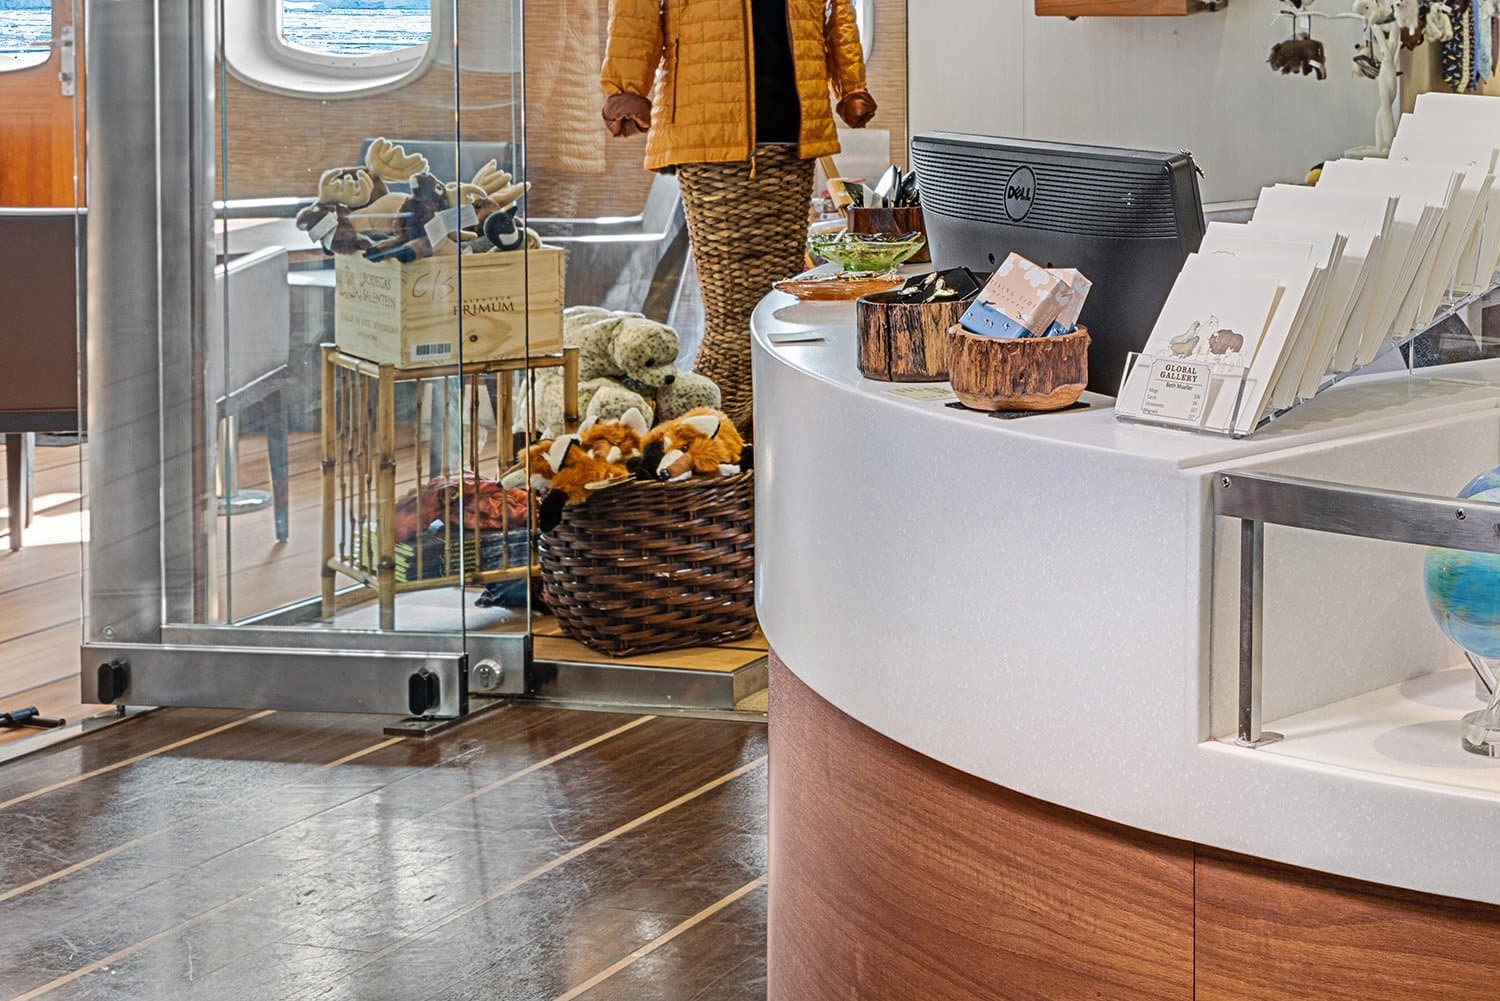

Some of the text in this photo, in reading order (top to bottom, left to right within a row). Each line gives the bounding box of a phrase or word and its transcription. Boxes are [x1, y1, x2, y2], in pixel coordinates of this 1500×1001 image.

[1007, 185, 1031, 201] DELL
[1165, 364, 1197, 374] GLOBAL
[1160, 371, 1198, 383] GALLERY
